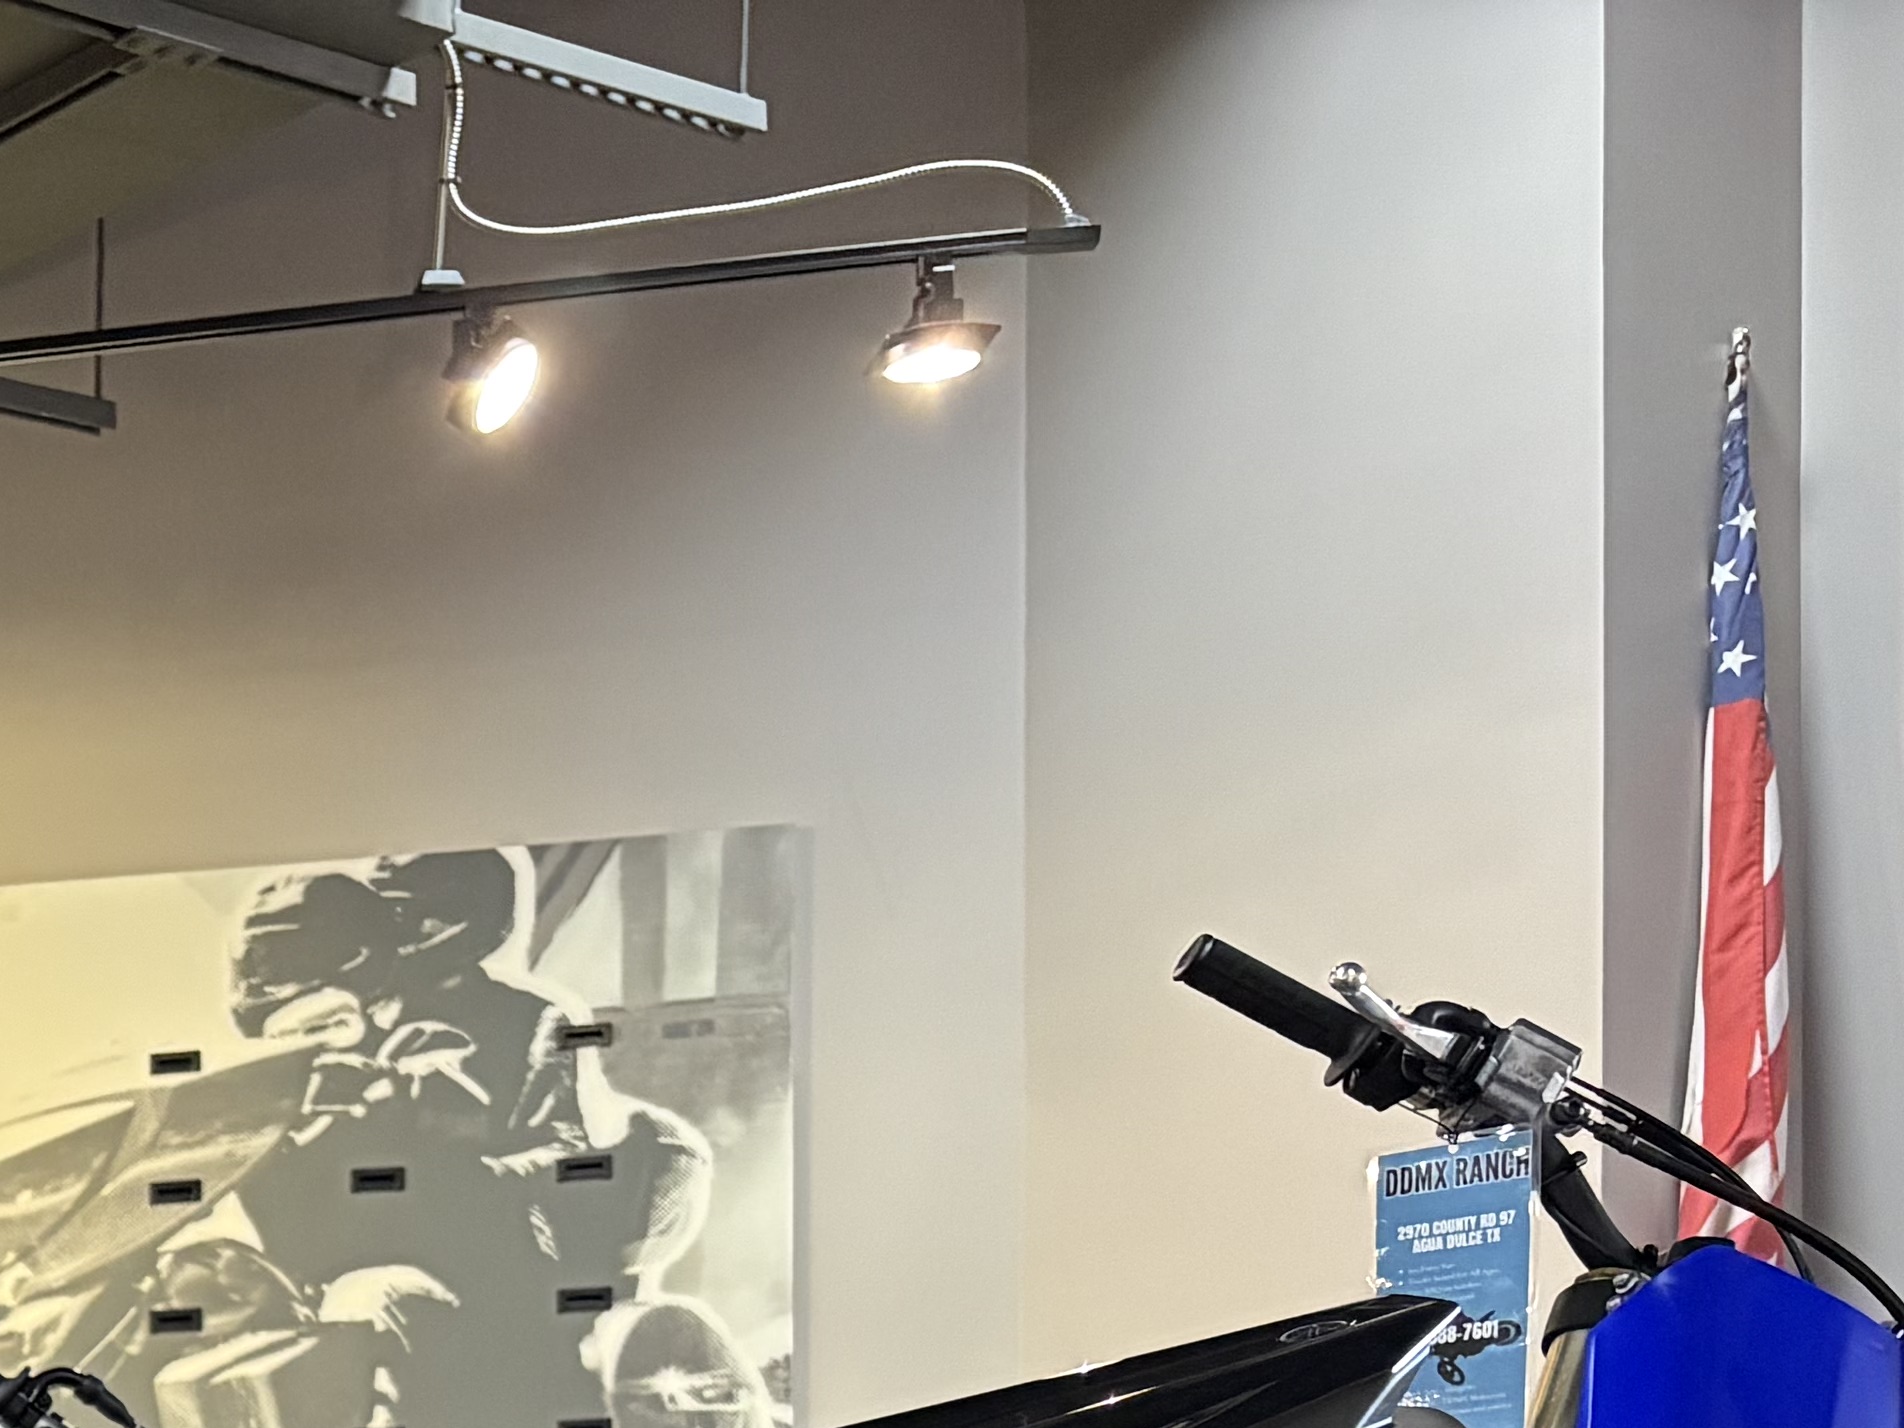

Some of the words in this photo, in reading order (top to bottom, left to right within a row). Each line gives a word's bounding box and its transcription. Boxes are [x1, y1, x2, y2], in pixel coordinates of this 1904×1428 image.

[1384, 1159, 1449, 1198] DDMX
[1454, 1146, 1532, 1187] RANCH
[1397, 1223, 1430, 1241] 2970
[1432, 1215, 1478, 1235] COUNTY
[1499, 1209, 1517, 1226] 97
[1412, 1236, 1444, 1254] AGUA
[1446, 1231, 1484, 1250] DULCE
[1486, 1227, 1502, 1243] TX
